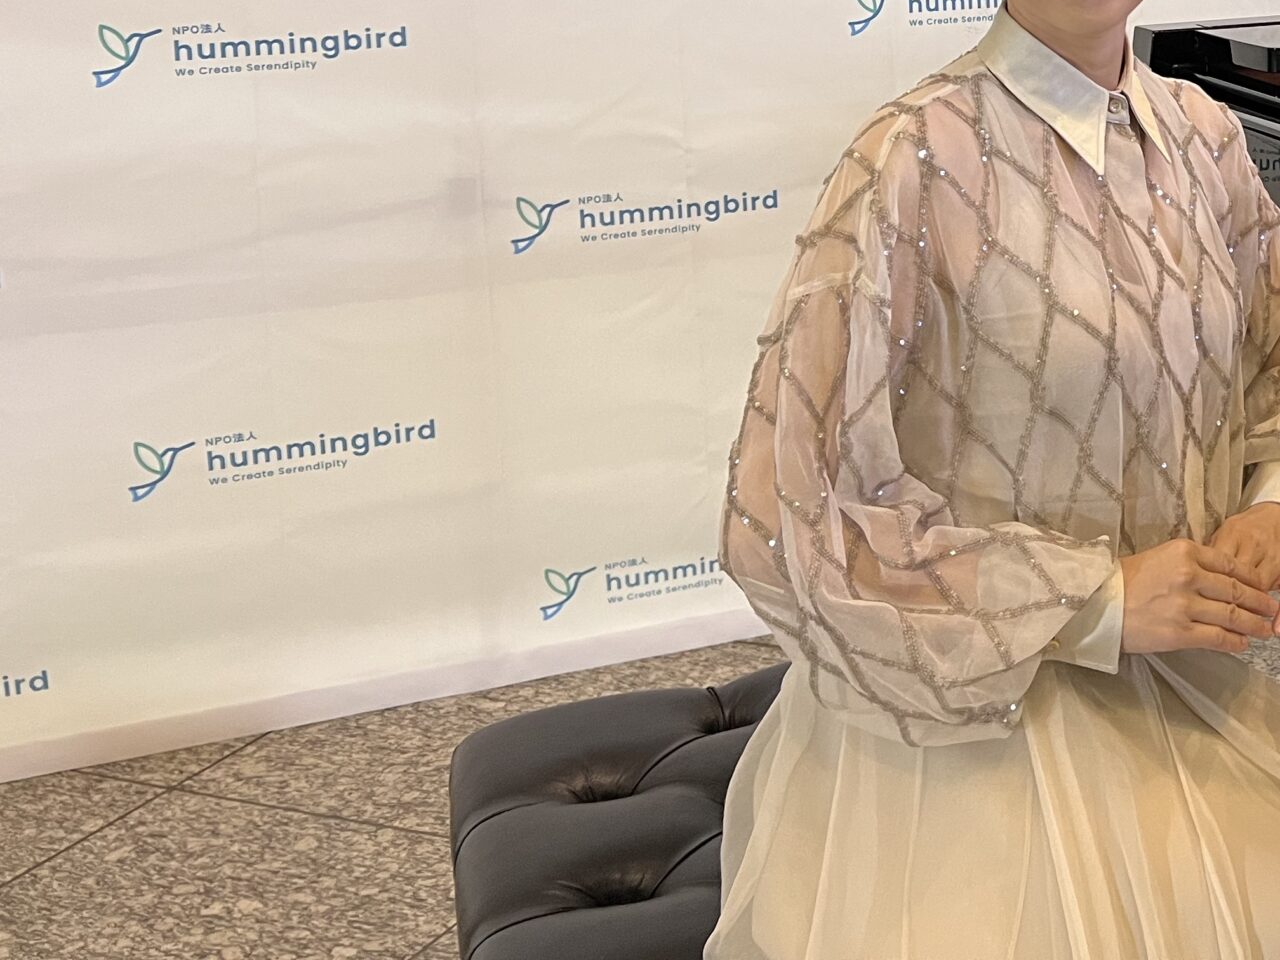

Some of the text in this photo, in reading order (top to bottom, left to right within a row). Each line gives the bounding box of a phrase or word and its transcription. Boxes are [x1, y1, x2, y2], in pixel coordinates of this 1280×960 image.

[172, 22, 226, 36] NPO法人
[173, 26, 408, 62] hummingbird
[175, 59, 318, 77] We Create Serendipity
[579, 189, 778, 229] hummingbird
[580, 223, 701, 243] We Create Serendipity
[205, 431, 258, 447] NPO法人
[206, 418, 436, 472] hummingbird
[208, 458, 348, 486] We Create Serendipity
[2, 669, 49, 697] ird
